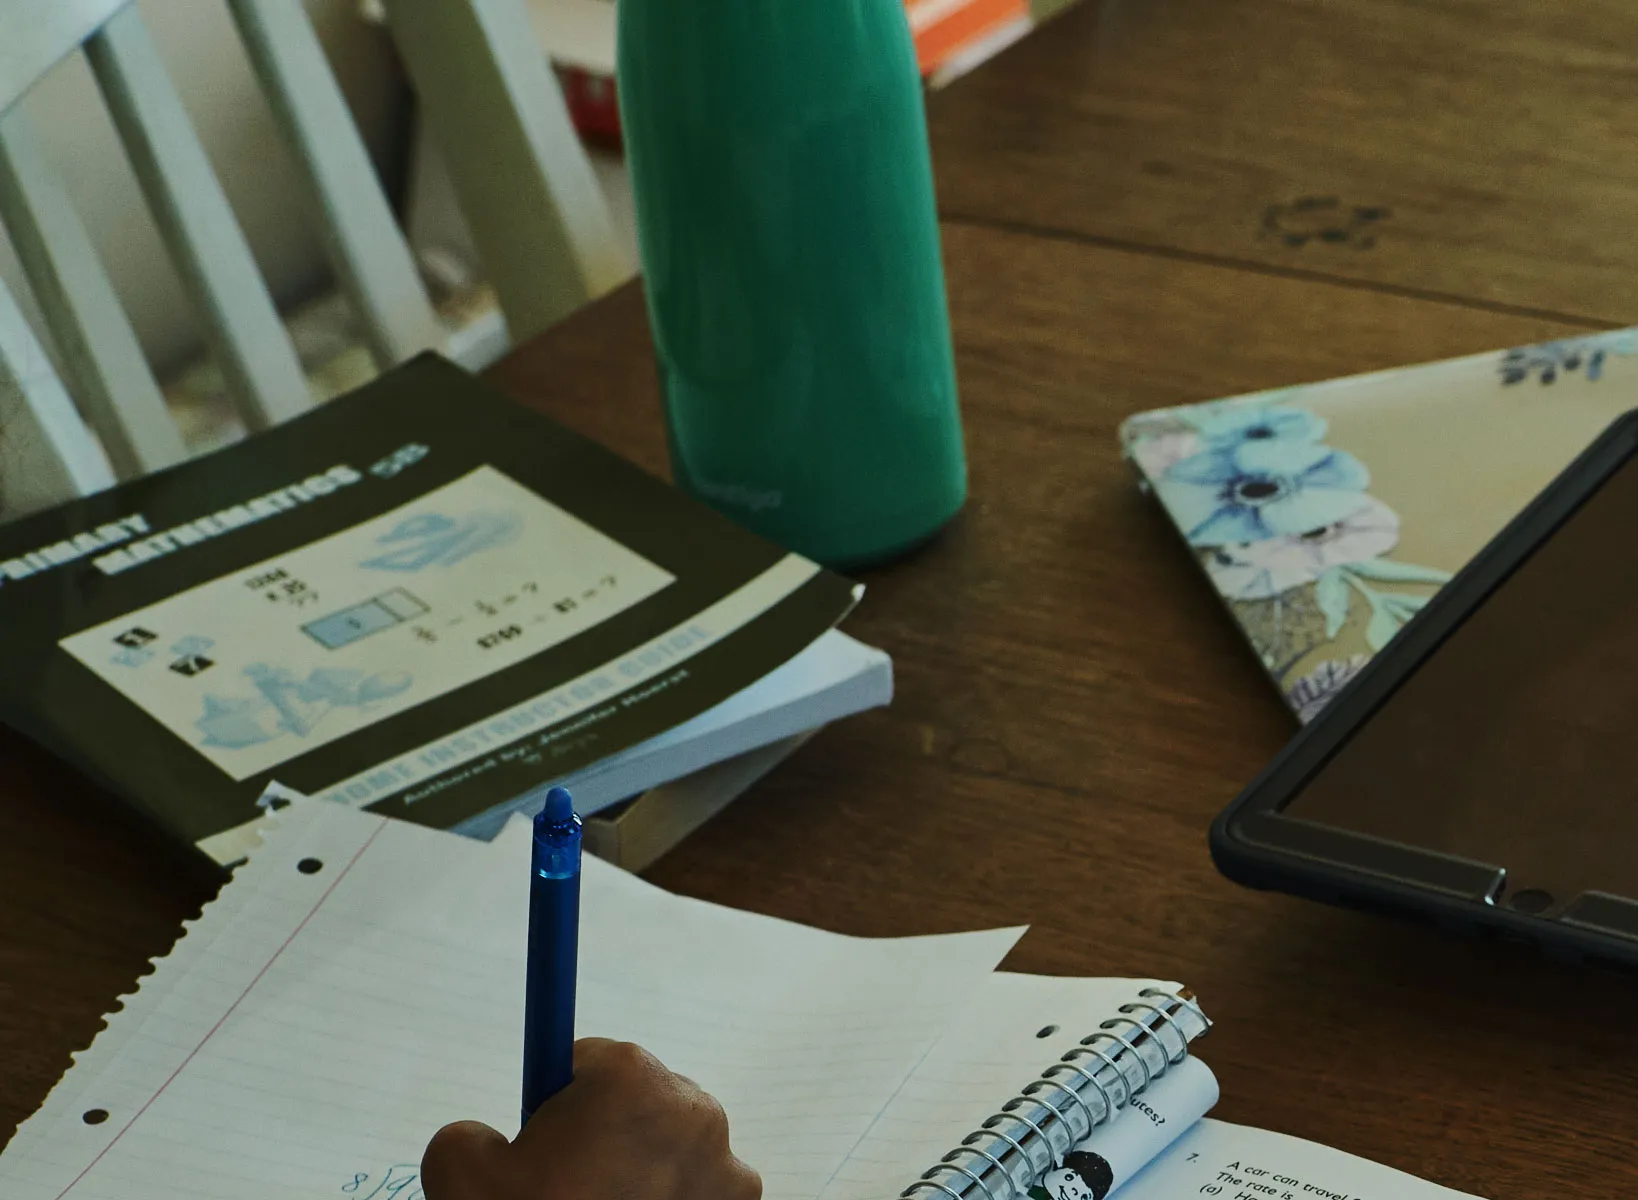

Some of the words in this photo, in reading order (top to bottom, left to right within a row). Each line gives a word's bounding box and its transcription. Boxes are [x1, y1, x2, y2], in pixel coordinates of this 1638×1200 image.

[92, 464, 362, 576] MATHEMATICS
[0, 513, 150, 582] RIMARY
[616, 623, 709, 678] GUIDE
[1185, 1151, 1200, 1163] 7.
[1226, 1160, 1240, 1171] A
[1243, 1166, 1270, 1177] car
[1271, 1173, 1299, 1187] can
[1198, 1182, 1223, 1196] (a)
[1215, 1170, 1243, 1186] The
[1244, 1180, 1278, 1196] rate
[1279, 1189, 1294, 1200] is
